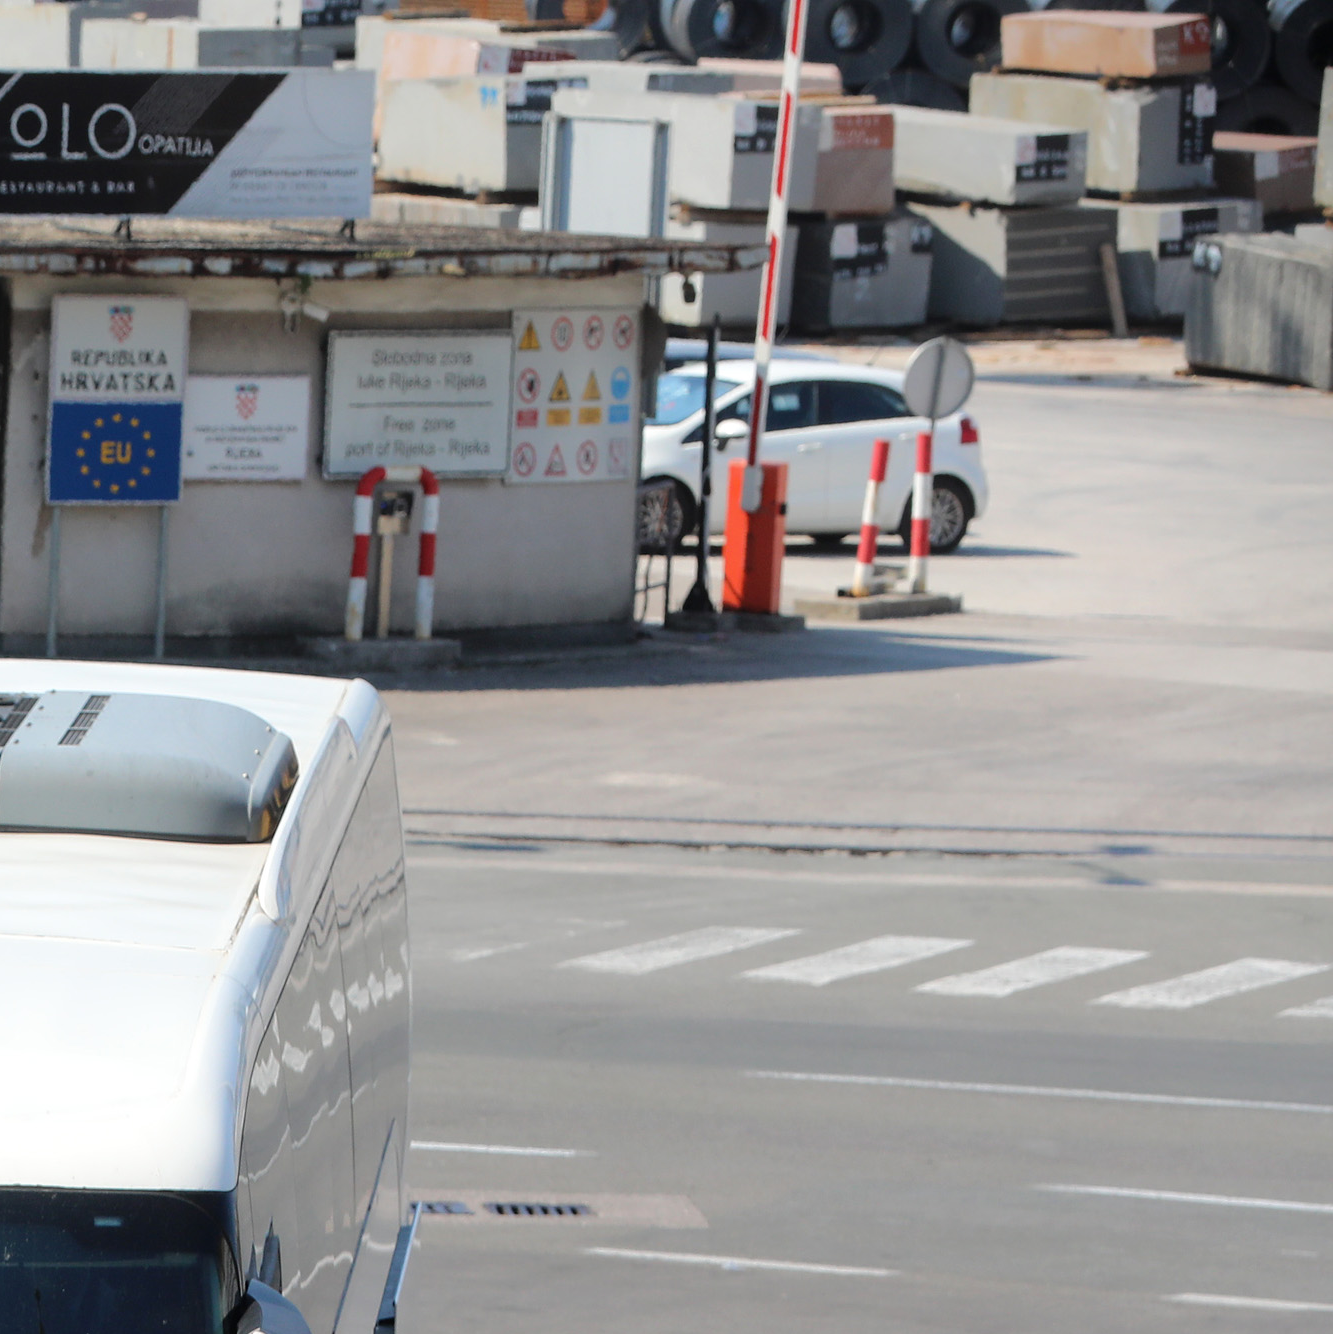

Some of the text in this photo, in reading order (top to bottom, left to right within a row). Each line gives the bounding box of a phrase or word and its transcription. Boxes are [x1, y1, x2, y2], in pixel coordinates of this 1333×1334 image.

[138, 134, 214, 157] OPATIJA
[107, 180, 136, 194] BAR
[70, 350, 167, 367] REPUBLIKA
[371, 349, 473, 367] Slobodna zona
[60, 372, 177, 392] HRVATSKA
[388, 372, 432, 394] Rijeka
[444, 373, 487, 394] Rijeka
[382, 415, 456, 434] Free zone
[99, 441, 132, 464] EU
[376, 439, 391, 457] of
[392, 439, 437, 460] Rijeka
[448, 439, 491, 460] Rijeka
